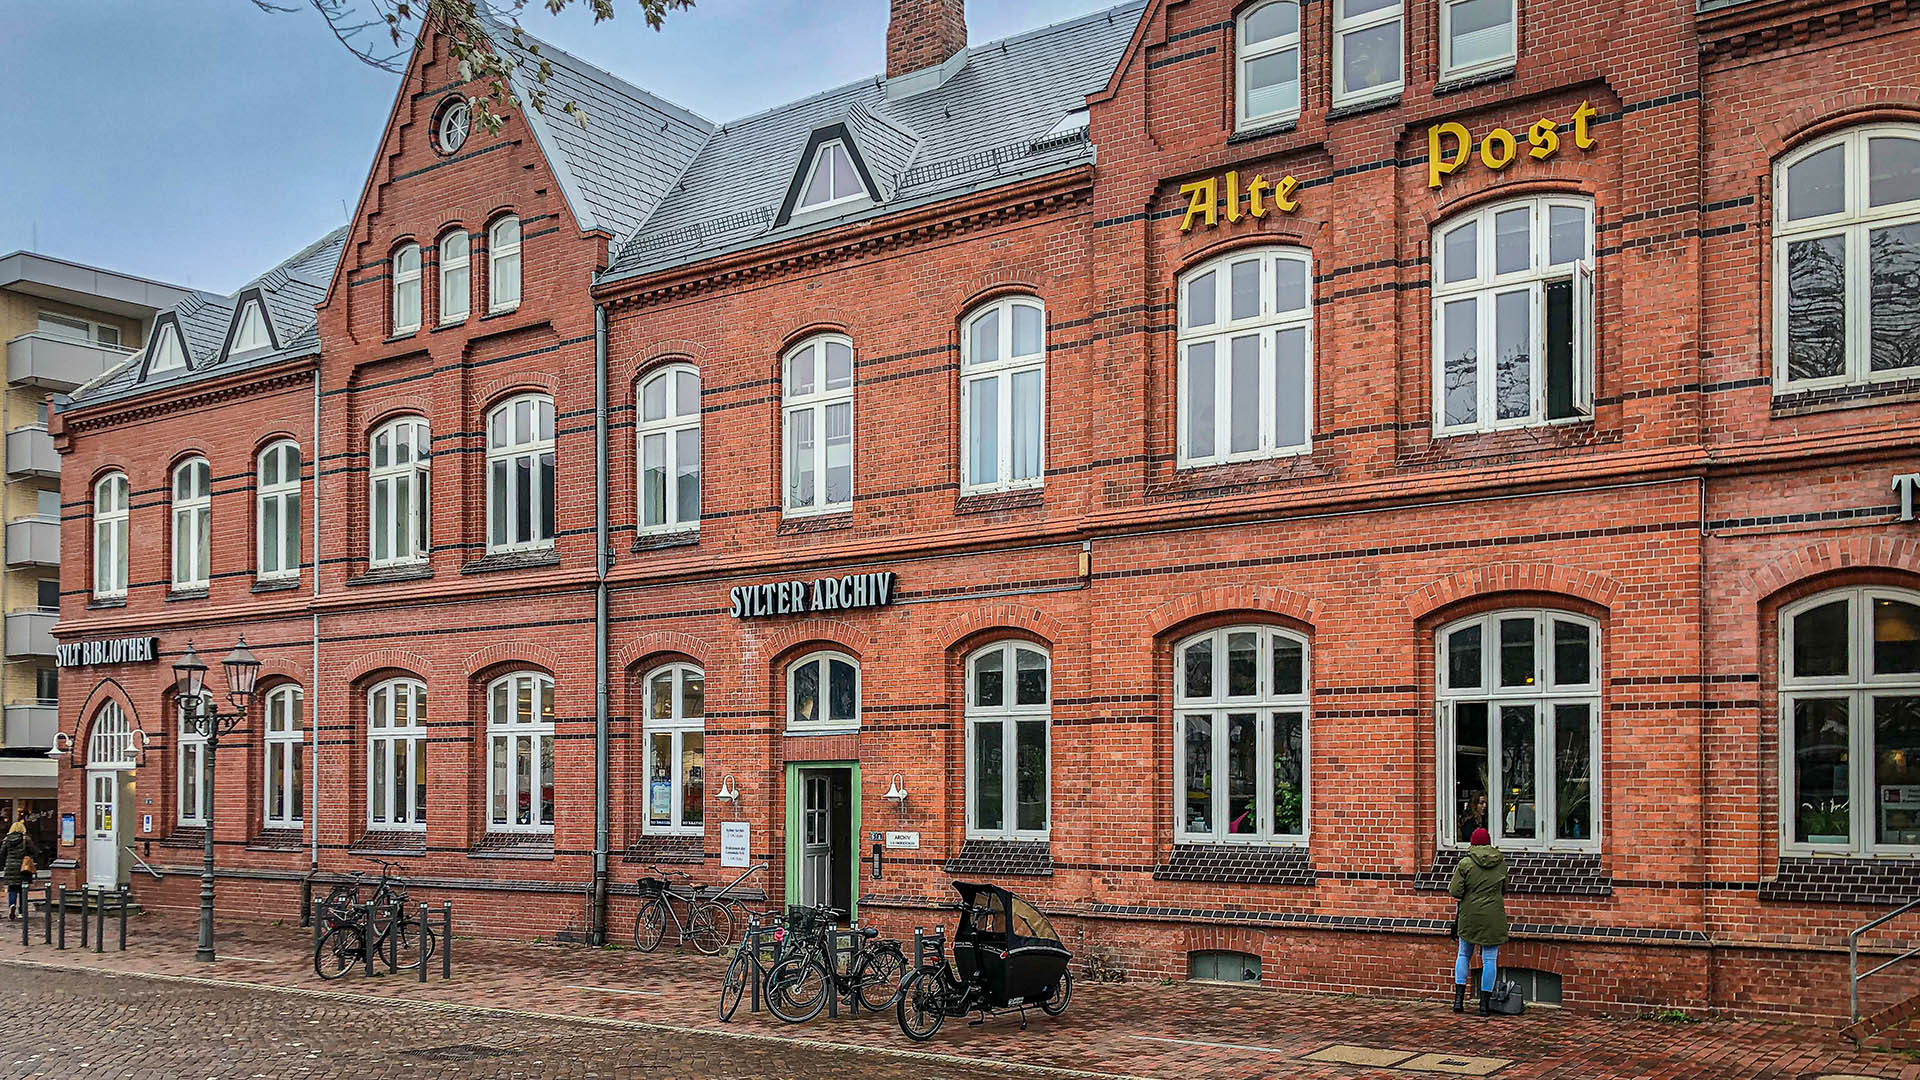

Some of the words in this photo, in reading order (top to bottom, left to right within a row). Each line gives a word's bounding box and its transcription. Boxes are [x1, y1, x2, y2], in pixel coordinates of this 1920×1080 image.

[1179, 170, 1301, 231] Alte
[1428, 100, 1598, 189] Post
[730, 580, 805, 618] SYLTER
[810, 572, 892, 611] ARCHIV
[55, 643, 81, 668] SYLT
[82, 637, 153, 665] BIBLIOTHEK
